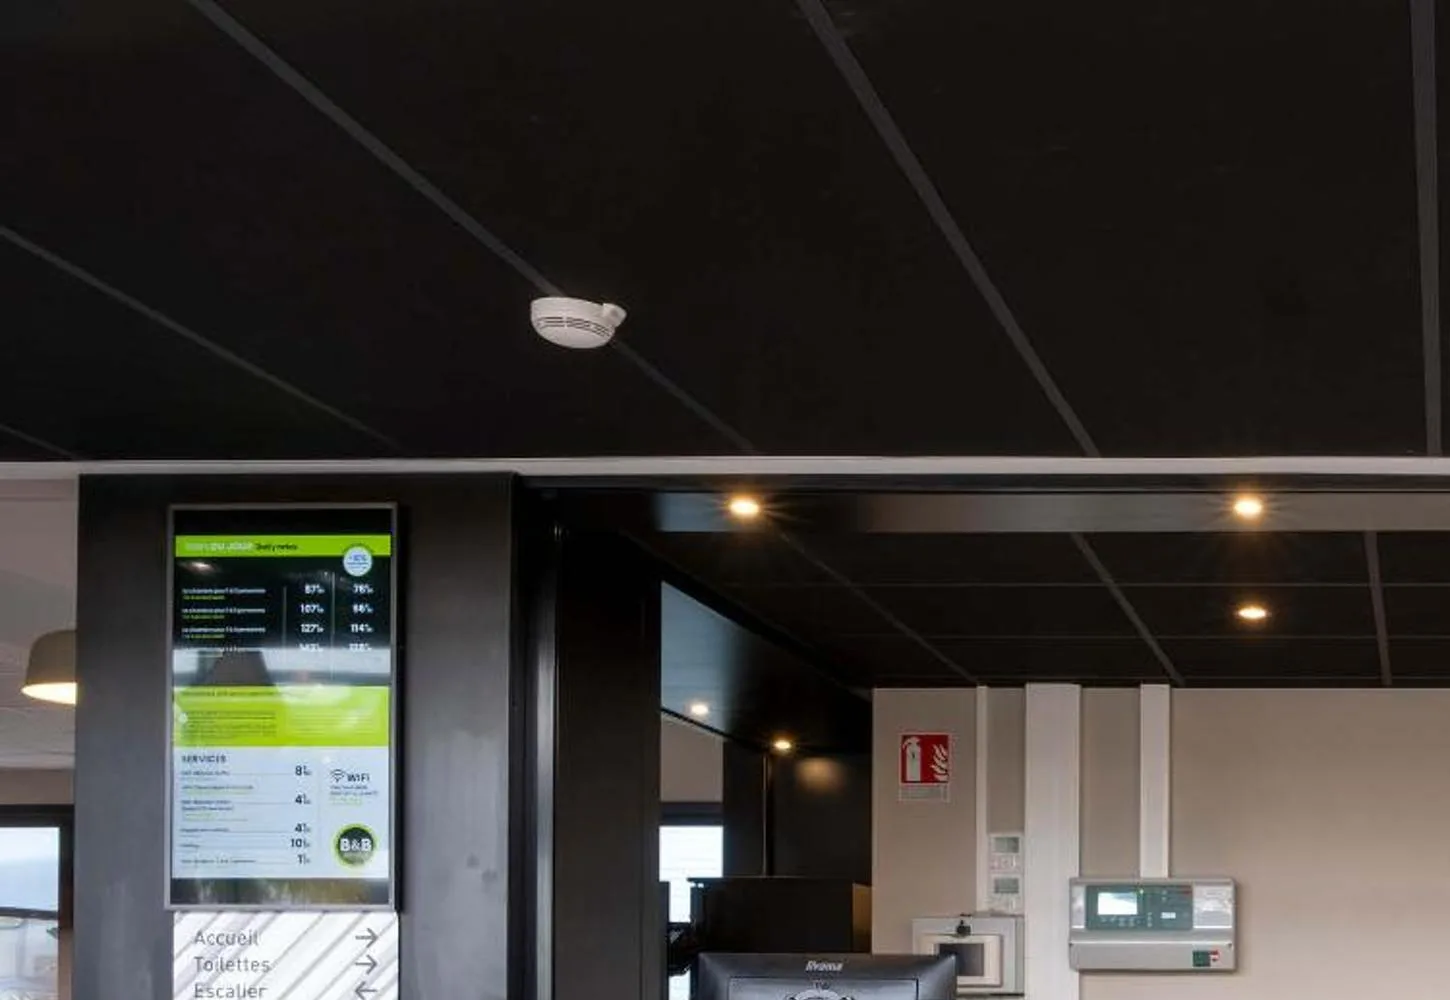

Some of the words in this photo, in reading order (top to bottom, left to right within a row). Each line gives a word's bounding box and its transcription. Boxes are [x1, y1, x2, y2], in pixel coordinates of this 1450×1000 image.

[193, 929, 259, 946] Accueil
[193, 955, 272, 973] Toilettes
[194, 983, 268, 999] Escalier
